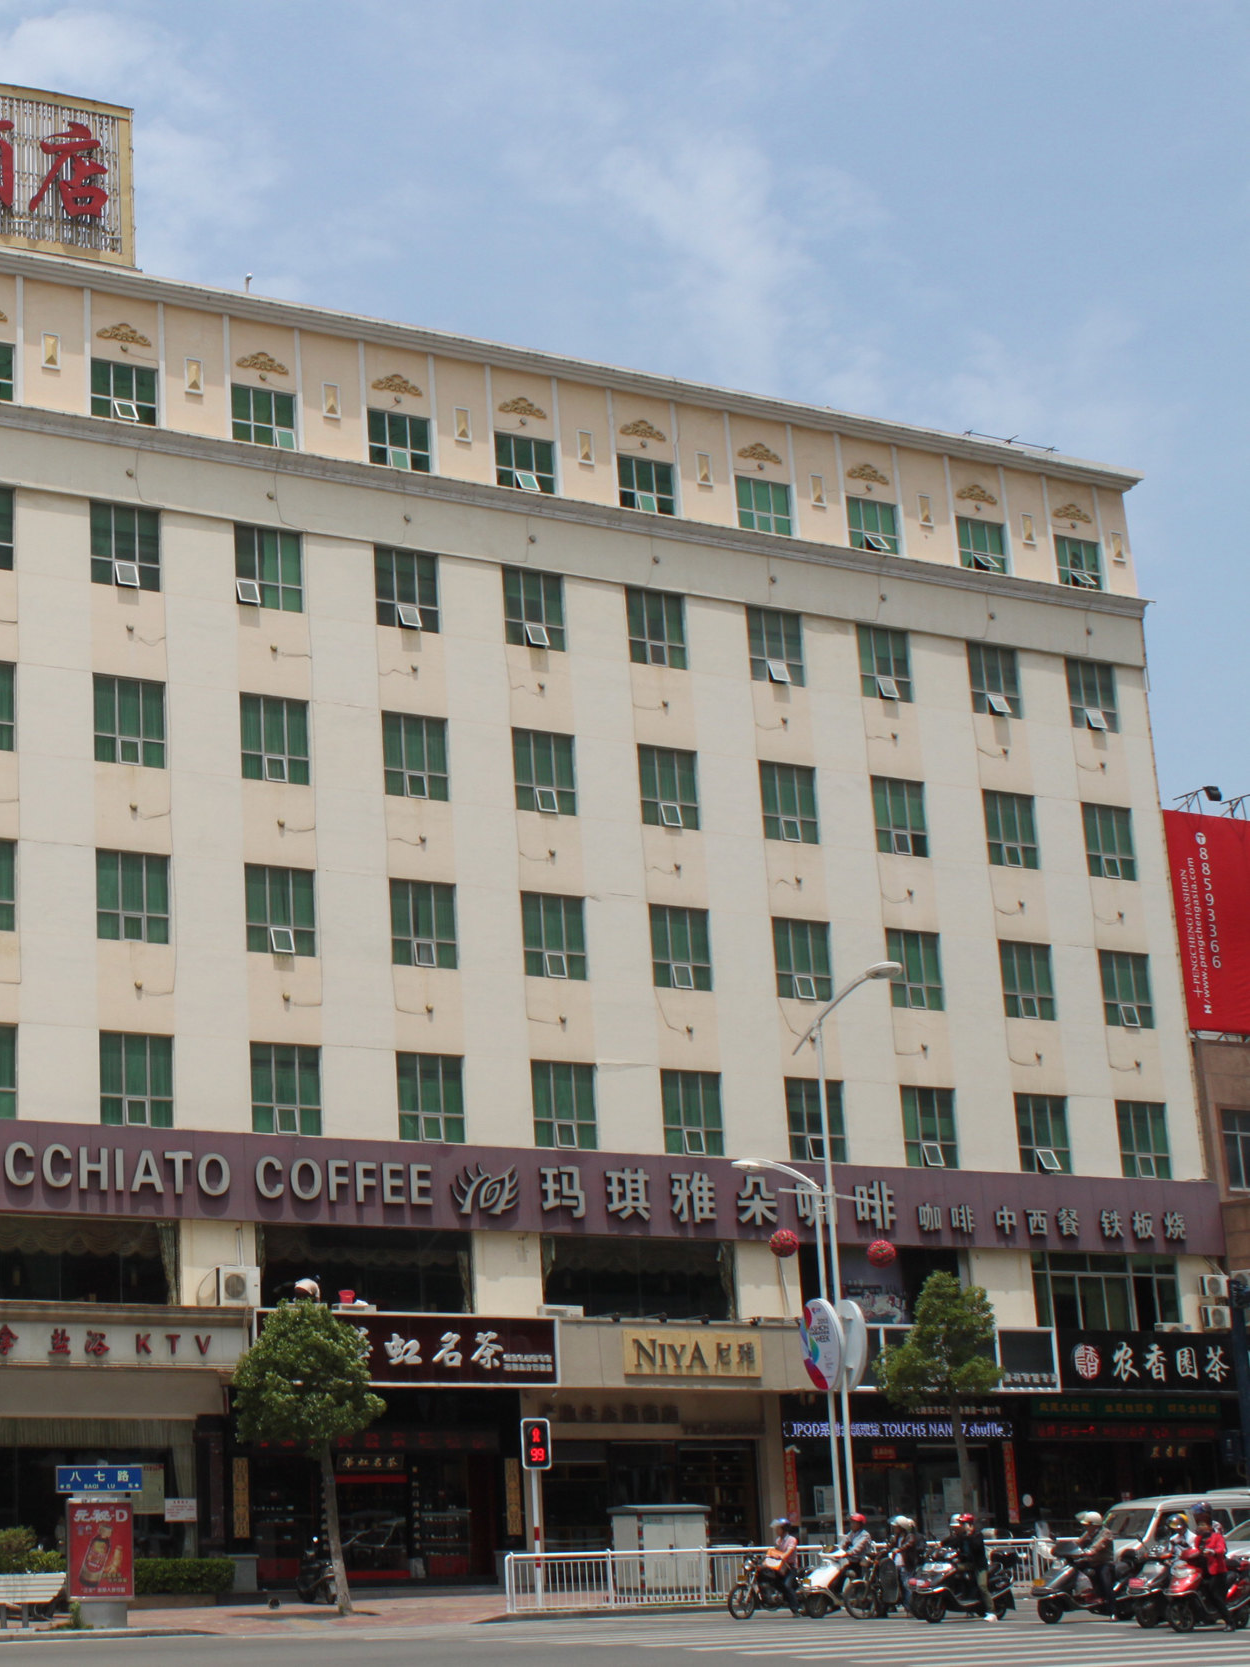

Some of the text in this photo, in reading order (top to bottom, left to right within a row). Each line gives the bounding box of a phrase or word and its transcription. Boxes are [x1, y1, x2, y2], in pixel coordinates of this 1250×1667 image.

[1199, 847, 1222, 968] 88593366
[255, 1155, 434, 1206] COFFEE
[918, 1204, 975, 1235] 咖啡
[996, 1206, 1079, 1237] 中西餐
[1101, 1209, 1187, 1240] 铁板烧
[135, 1333, 212, 1356] KTV
[632, 1338, 709, 1369] NIYA
[969, 1422, 1004, 1435] shuffle
[530, 1447, 545, 1462] 99
[69, 1470, 129, 1483] 八七路
